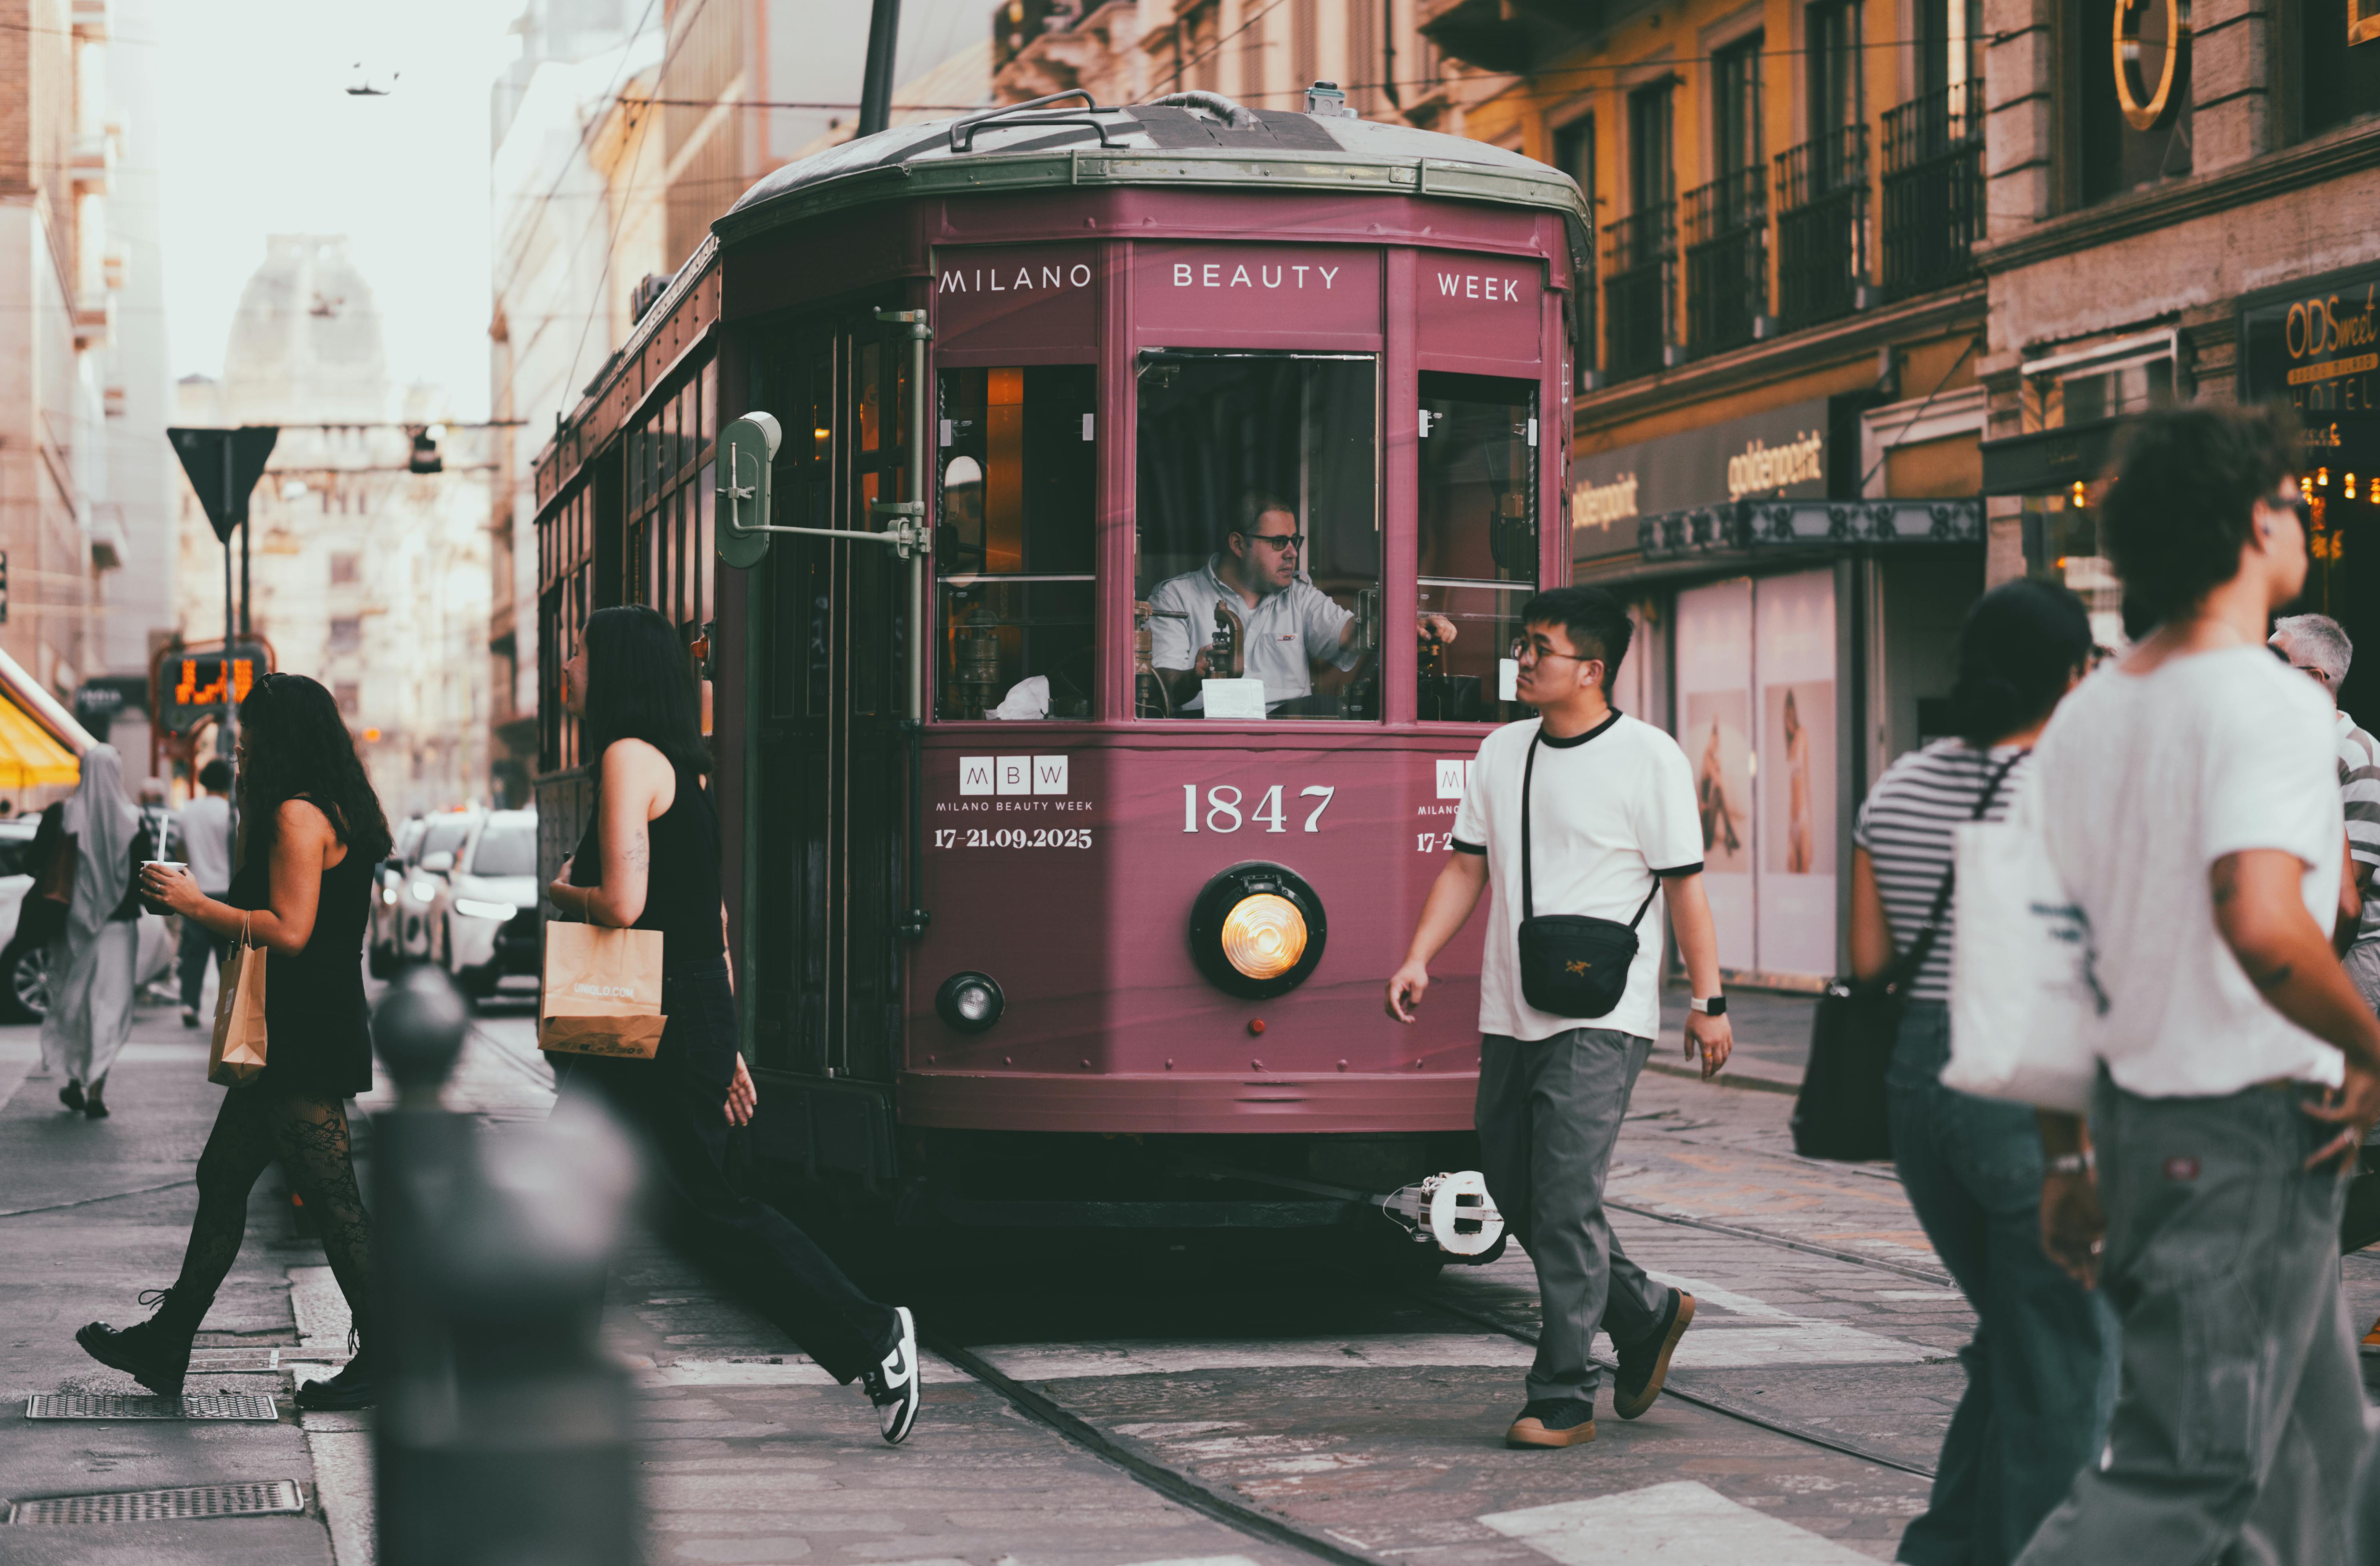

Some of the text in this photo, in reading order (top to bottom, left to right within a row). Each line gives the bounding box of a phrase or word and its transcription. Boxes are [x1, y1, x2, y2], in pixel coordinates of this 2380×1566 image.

[939, 263, 1519, 302] MILANO BEAUTY WEEK
[2293, 377, 2372, 409] HOTEL
[1728, 429, 1822, 503] goldenpoint
[966, 766, 1062, 785] MBW
[936, 801, 1092, 811] MILANO BEAUTY WEEK
[1183, 785, 1335, 833] 1847
[574, 982, 634, 998] UNIQLO.COM
